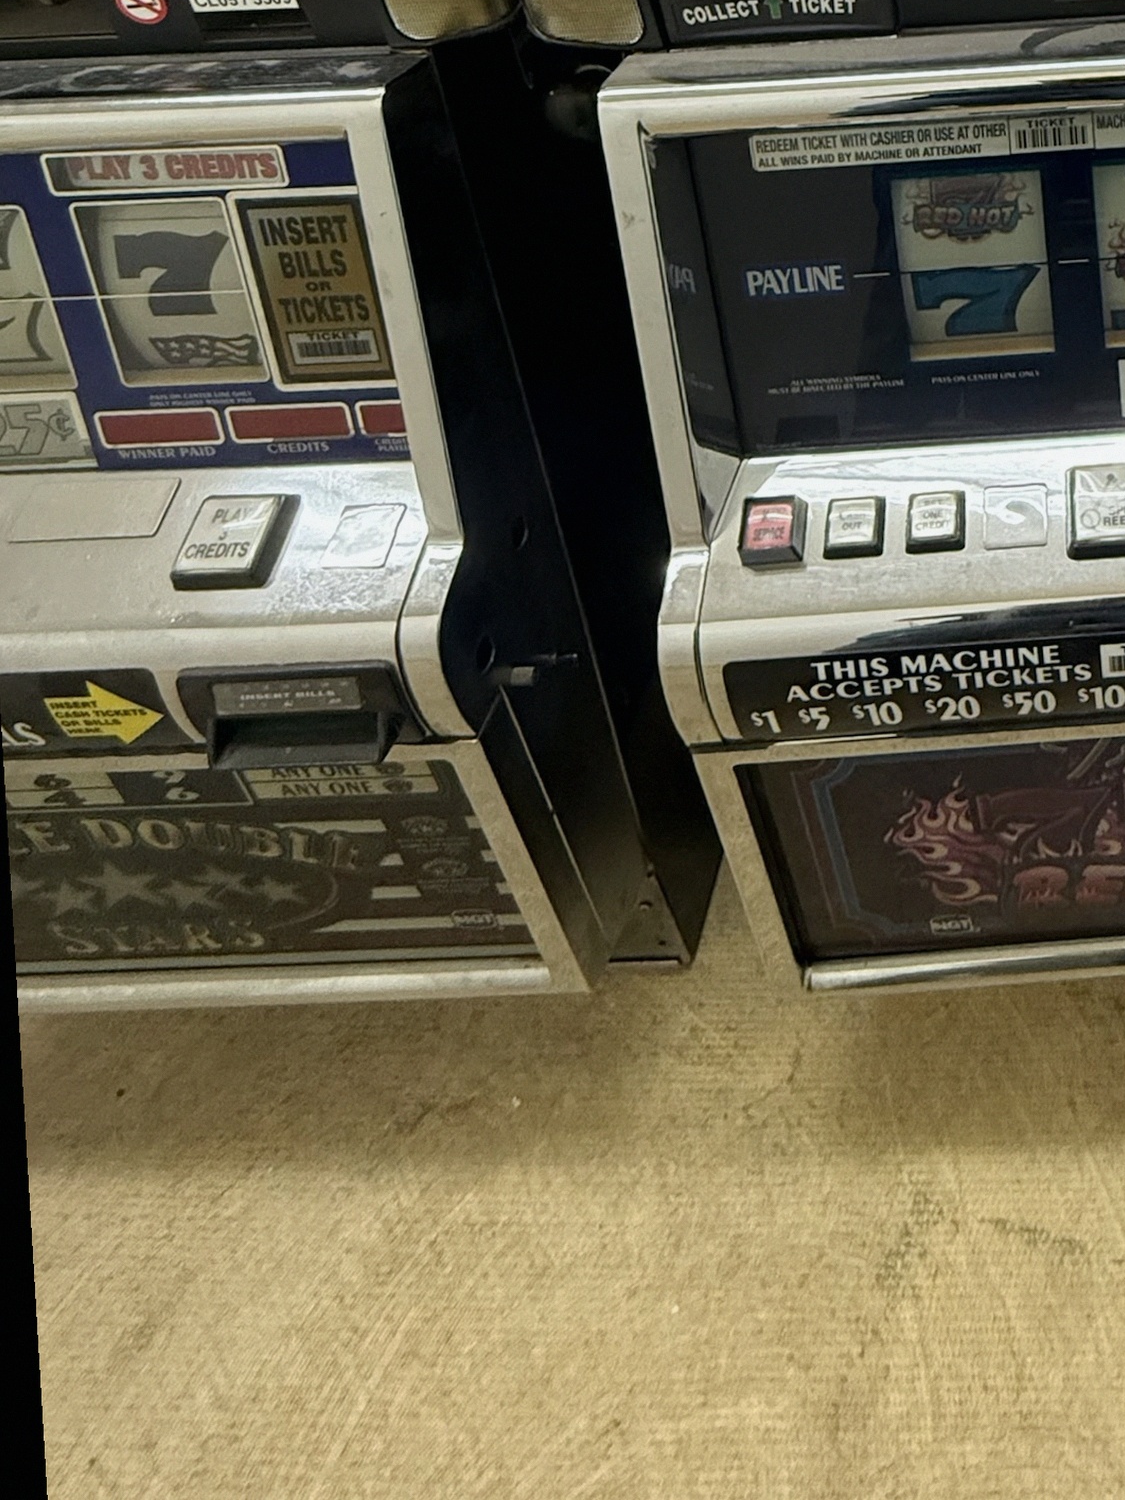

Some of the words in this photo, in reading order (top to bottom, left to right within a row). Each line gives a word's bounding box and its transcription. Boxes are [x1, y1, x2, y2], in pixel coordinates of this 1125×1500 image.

[682, 0, 759, 26] COLLECT
[756, 135, 800, 154] REDEEM
[802, 133, 838, 151] TICKET
[840, 131, 867, 148] WITH
[869, 129, 916, 147] CASHIER
[916, 127, 932, 143] OR
[934, 127, 955, 142] USE
[957, 125, 970, 140] AT
[972, 122, 1007, 139] OTHER
[1026, 116, 1076, 128] TICKET
[67, 156, 132, 181] PLAY
[142, 156, 158, 180] 3
[164, 152, 277, 180] CREDITS
[758, 155, 778, 168] ALL
[780, 153, 808, 167] WINS
[810, 151, 836, 165] PAID
[838, 150, 852, 163] BY
[855, 147, 902, 162] MACHINE
[905, 146, 920, 159] OR
[922, 142, 982, 158] ATTENDANT
[258, 214, 348, 246] INSERT
[279, 249, 347, 278] BILLS
[305, 280, 331, 291] OR
[746, 265, 845, 297] PAYLINE
[278, 294, 370, 325] TICKETS
[118, 446, 176, 460] WINNER
[179, 445, 216, 457] PAID
[267, 441, 329, 453] CREDITS
[185, 541, 250, 559] CREDITS
[811, 657, 889, 681] THIS
[900, 645, 1060, 676] MACHINE
[240, 692, 290, 701] INSERT
[295, 690, 335, 698] BILLS
[787, 675, 943, 703] ACCEPTS
[953, 663, 1092, 690] TICKETS
[50, 700, 97, 709] INSERT
[56, 710, 91, 718] CASH
[94, 708, 147, 717] TICKETS
[750, 709, 782, 733] $1
[798, 707, 830, 731] $5
[852, 702, 903, 727] $10
[925, 696, 981, 722] $20
[1003, 690, 1057, 716] $50
[83, 718, 121, 726] BILLS
[281, 781, 322, 795] ANY
[329, 779, 374, 794] ONE
[81, 817, 361, 870] DOUBLE
[48, 920, 266, 954] STARS
